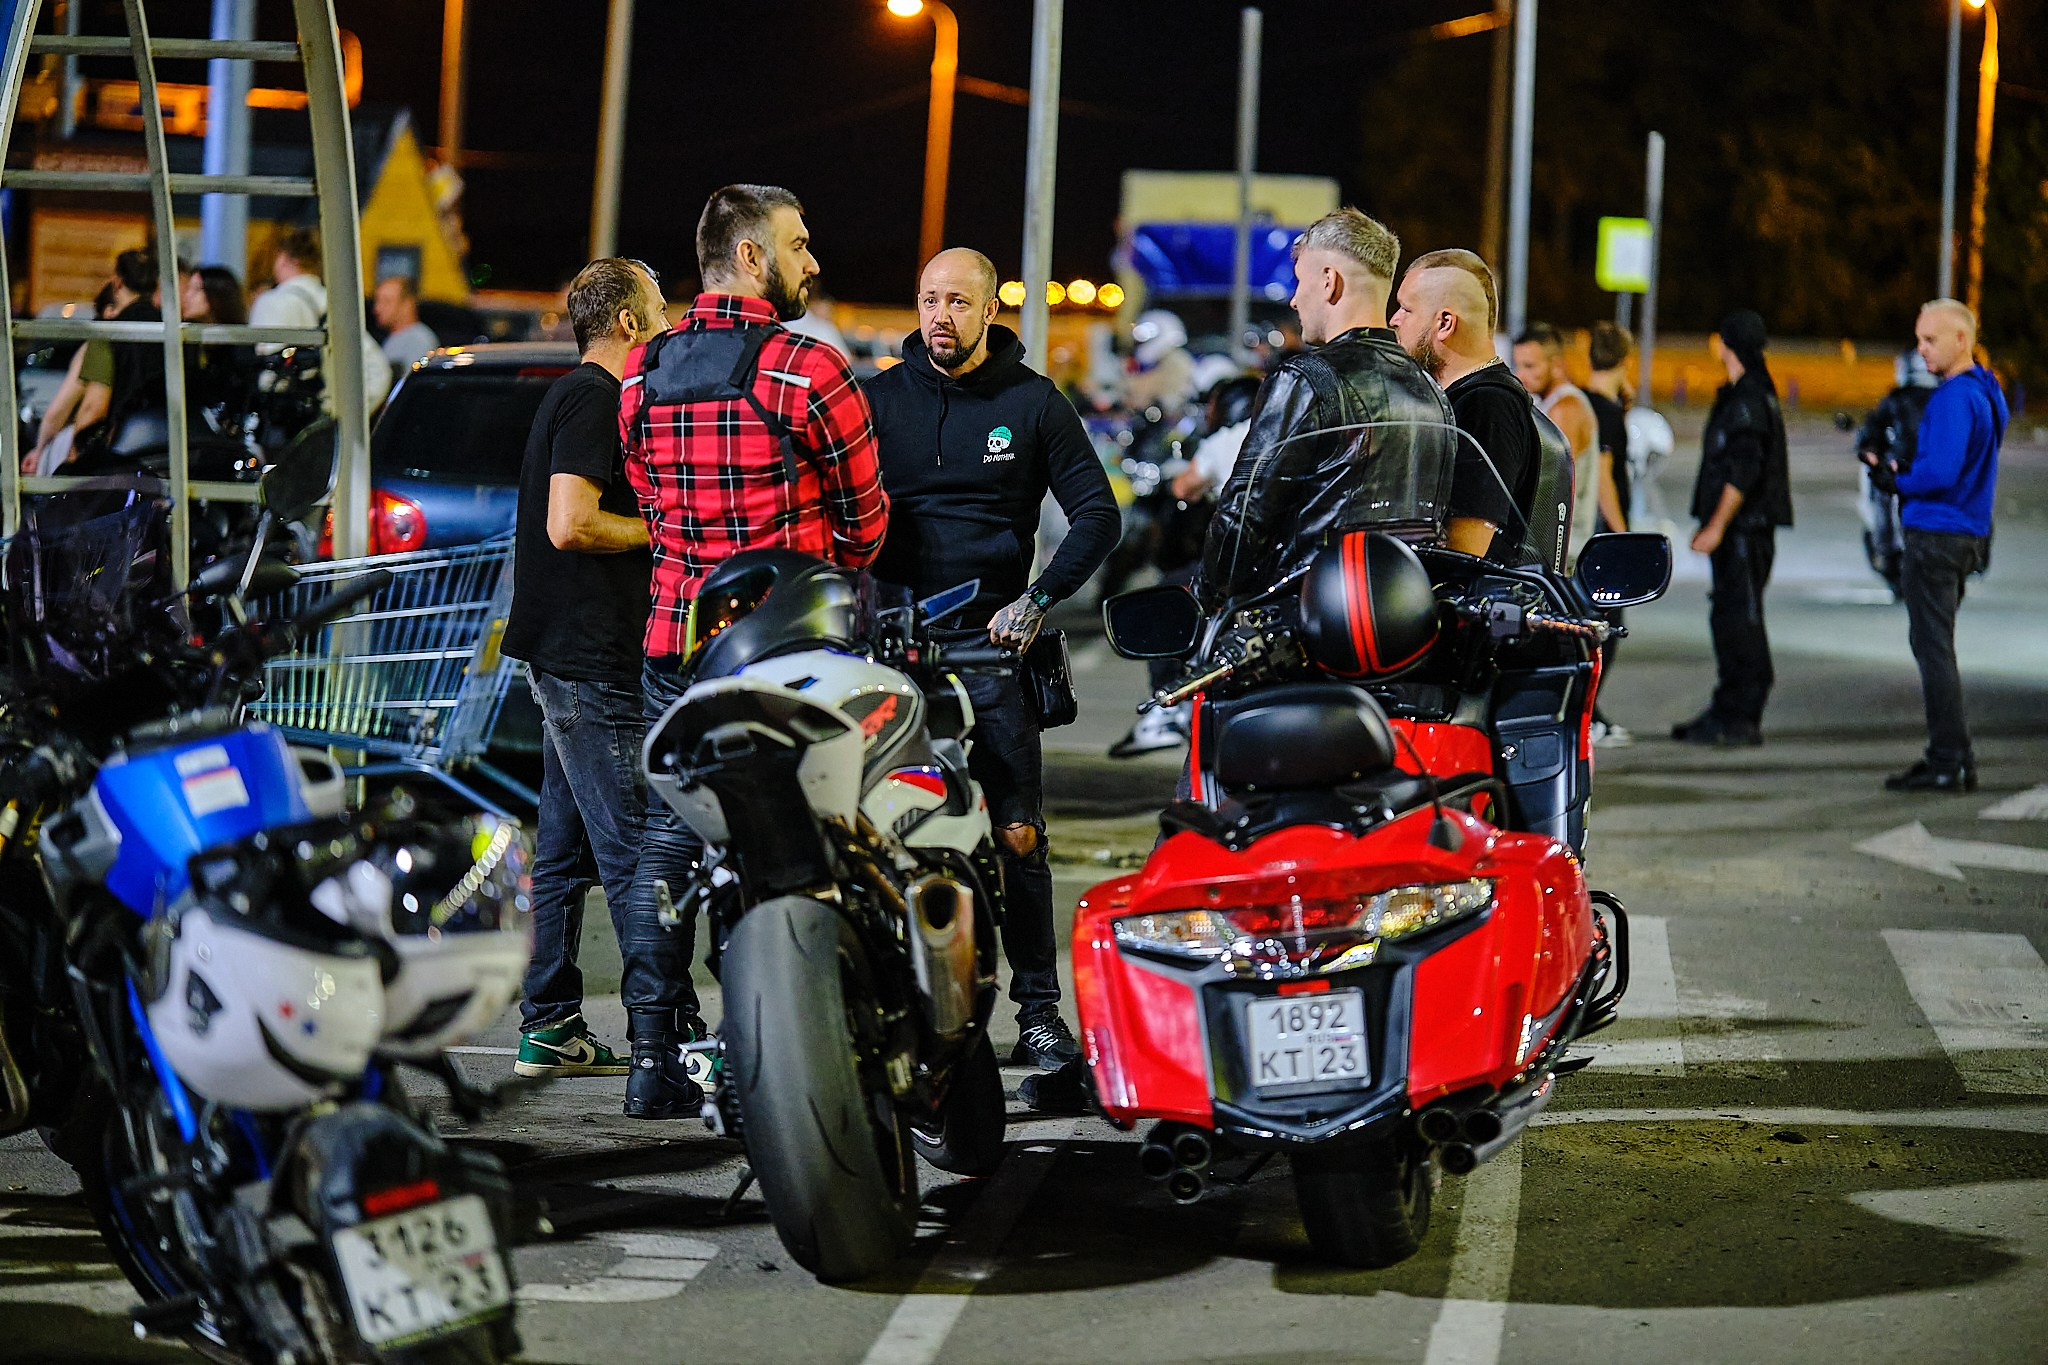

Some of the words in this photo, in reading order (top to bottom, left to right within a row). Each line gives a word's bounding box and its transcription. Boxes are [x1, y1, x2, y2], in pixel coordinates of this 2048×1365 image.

[983, 454, 992, 464] DO
[1269, 1002, 1348, 1034] 1892
[1260, 1049, 1304, 1079] KT
[1320, 1045, 1356, 1073] 23
[365, 1214, 466, 1271] 3126
[440, 1262, 493, 1310] 23
